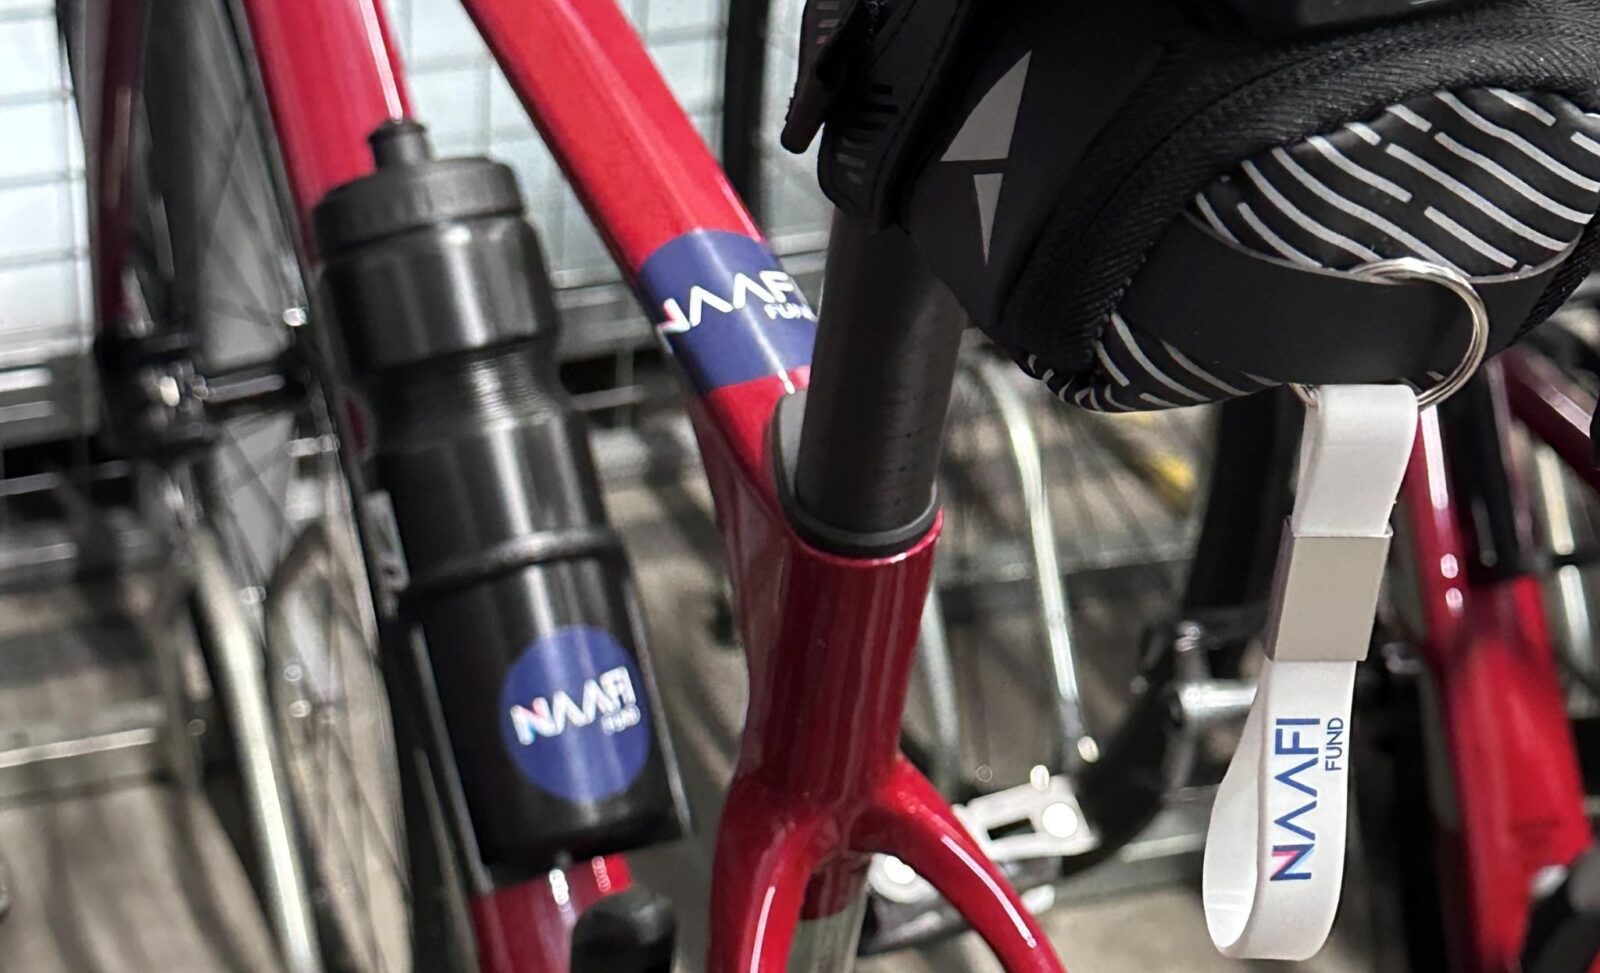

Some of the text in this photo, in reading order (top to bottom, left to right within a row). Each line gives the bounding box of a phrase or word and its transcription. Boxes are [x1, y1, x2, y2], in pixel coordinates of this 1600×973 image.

[656, 270, 795, 333] NAAF
[1324, 717, 1344, 772] FUND
[1269, 717, 1321, 882] NAAFI
